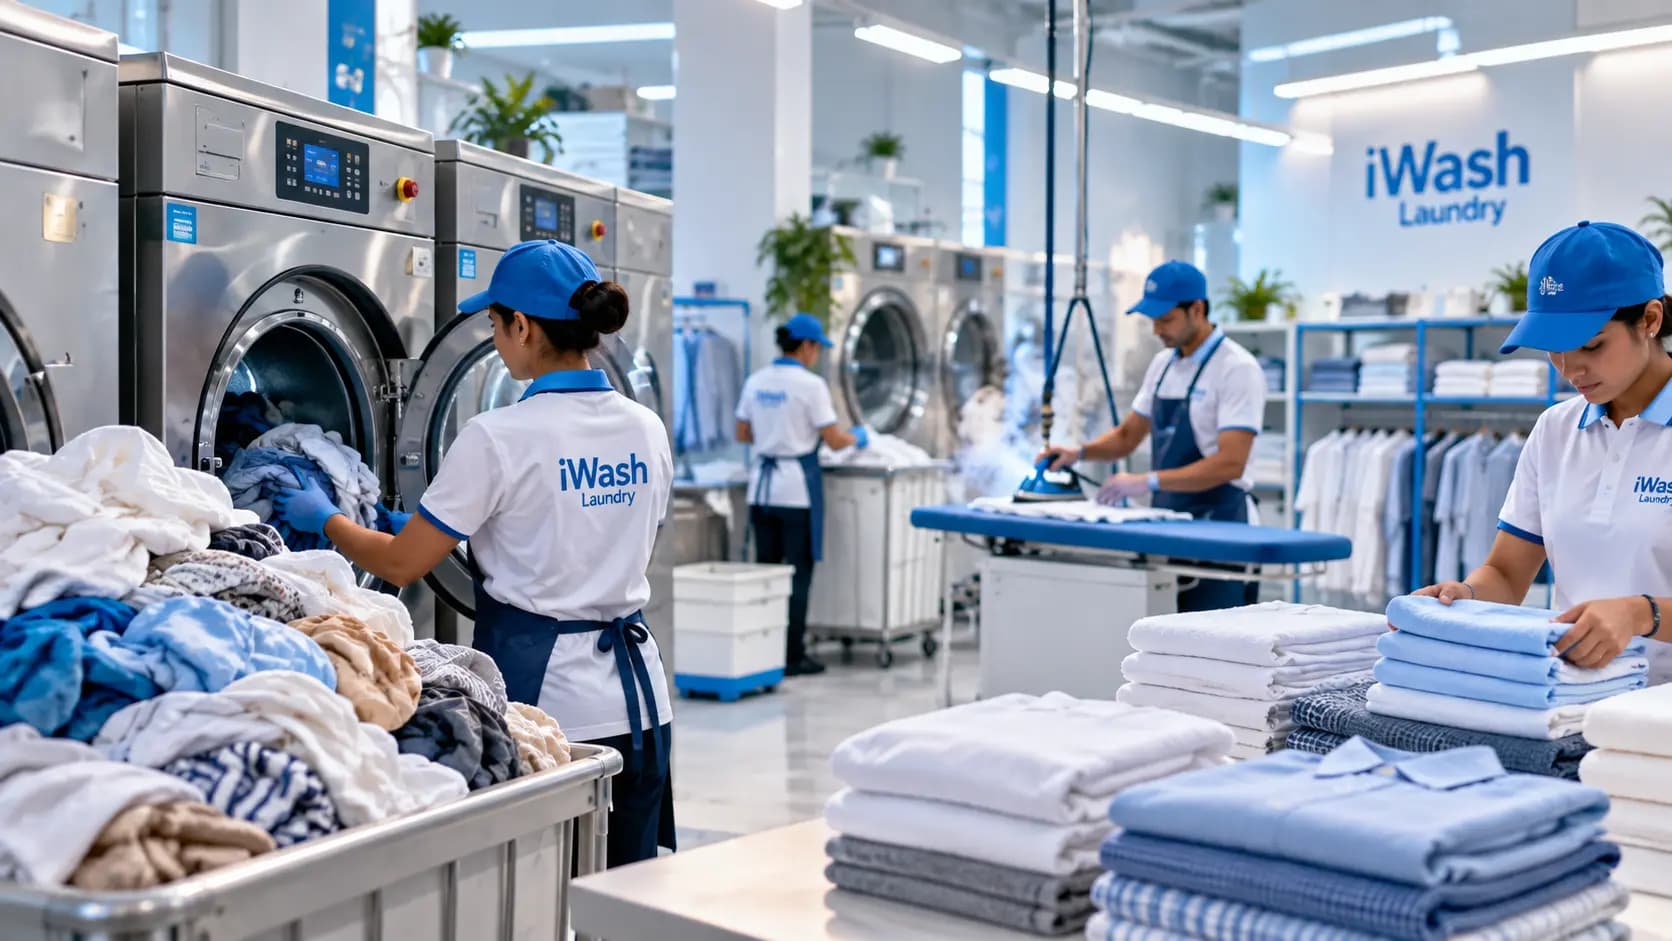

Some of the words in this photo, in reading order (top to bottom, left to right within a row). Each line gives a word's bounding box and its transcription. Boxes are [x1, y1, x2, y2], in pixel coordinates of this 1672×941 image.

[1366, 130, 1530, 198] iWash
[1399, 195, 1507, 227] Laundry
[558, 453, 648, 491] iWash
[581, 489, 636, 507] Laundry
